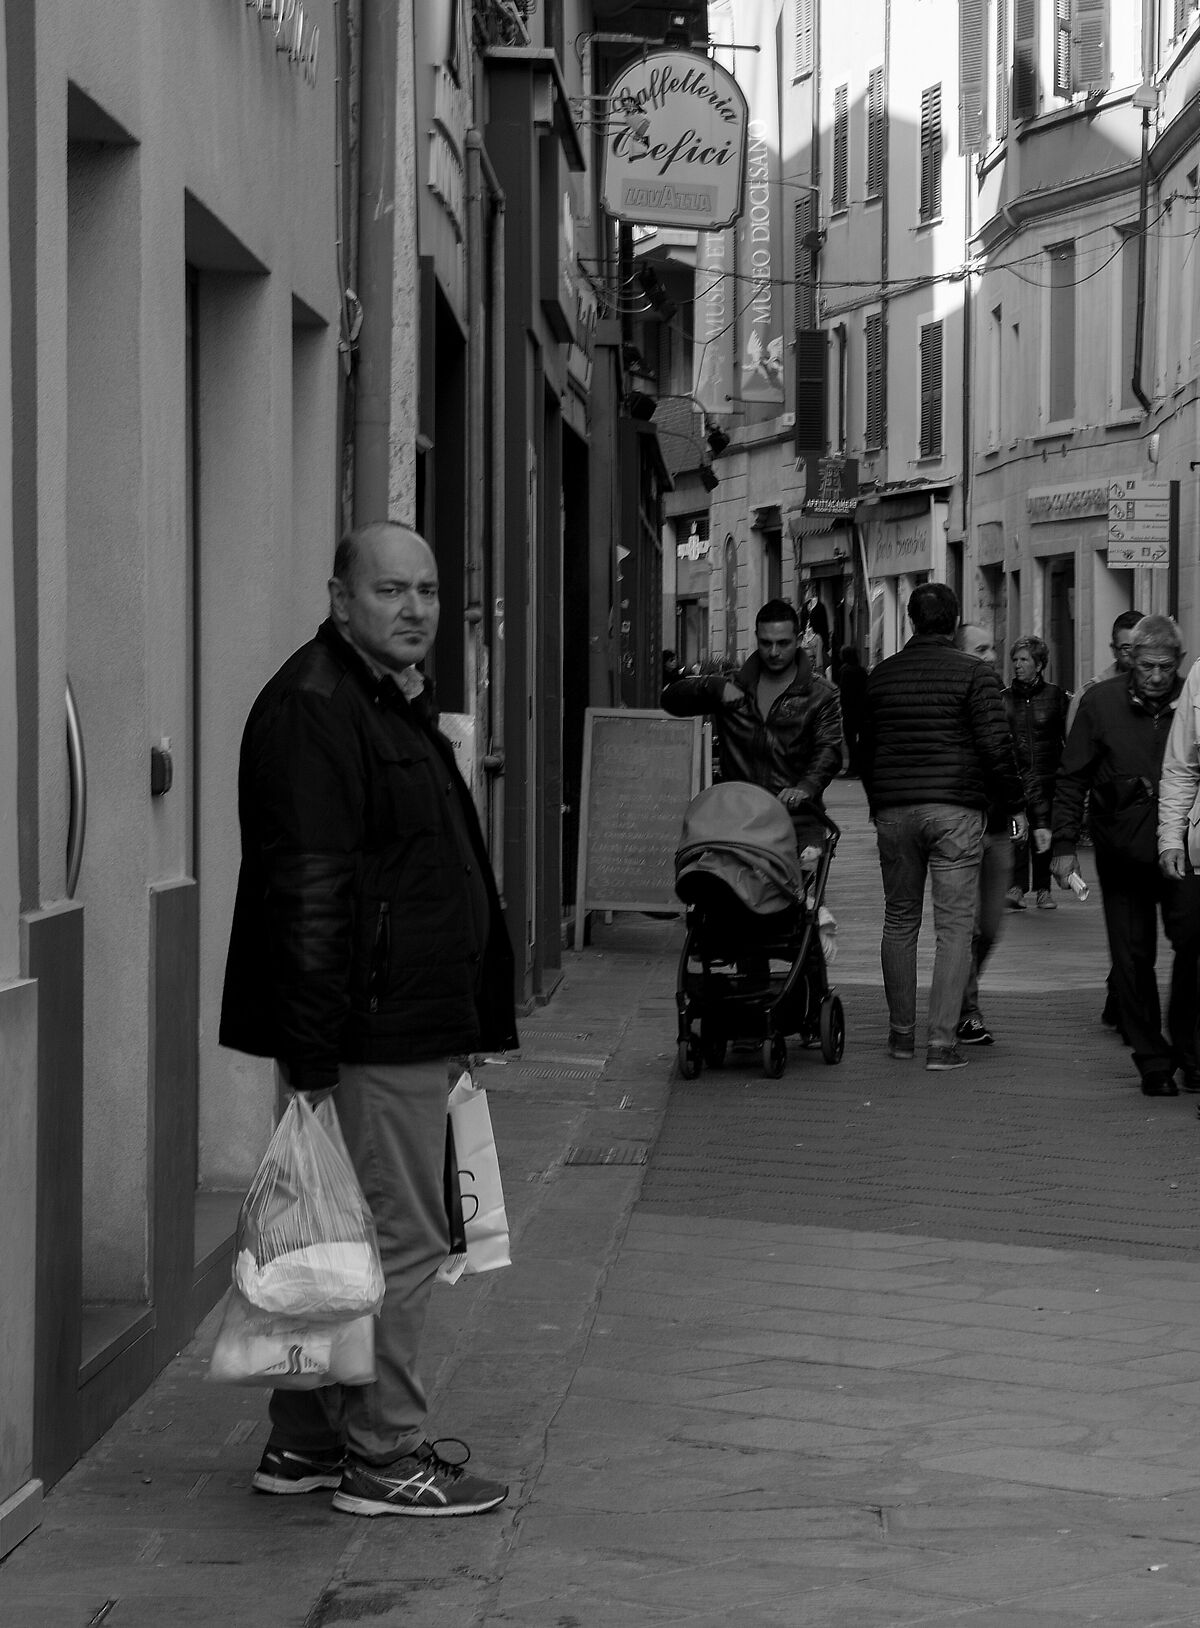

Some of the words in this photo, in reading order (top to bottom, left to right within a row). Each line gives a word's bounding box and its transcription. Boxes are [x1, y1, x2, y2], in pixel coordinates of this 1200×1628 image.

[612, 128, 736, 176] Oefici
[747, 118, 770, 242] DIOCESANO
[752, 249, 772, 325] MUSEO
